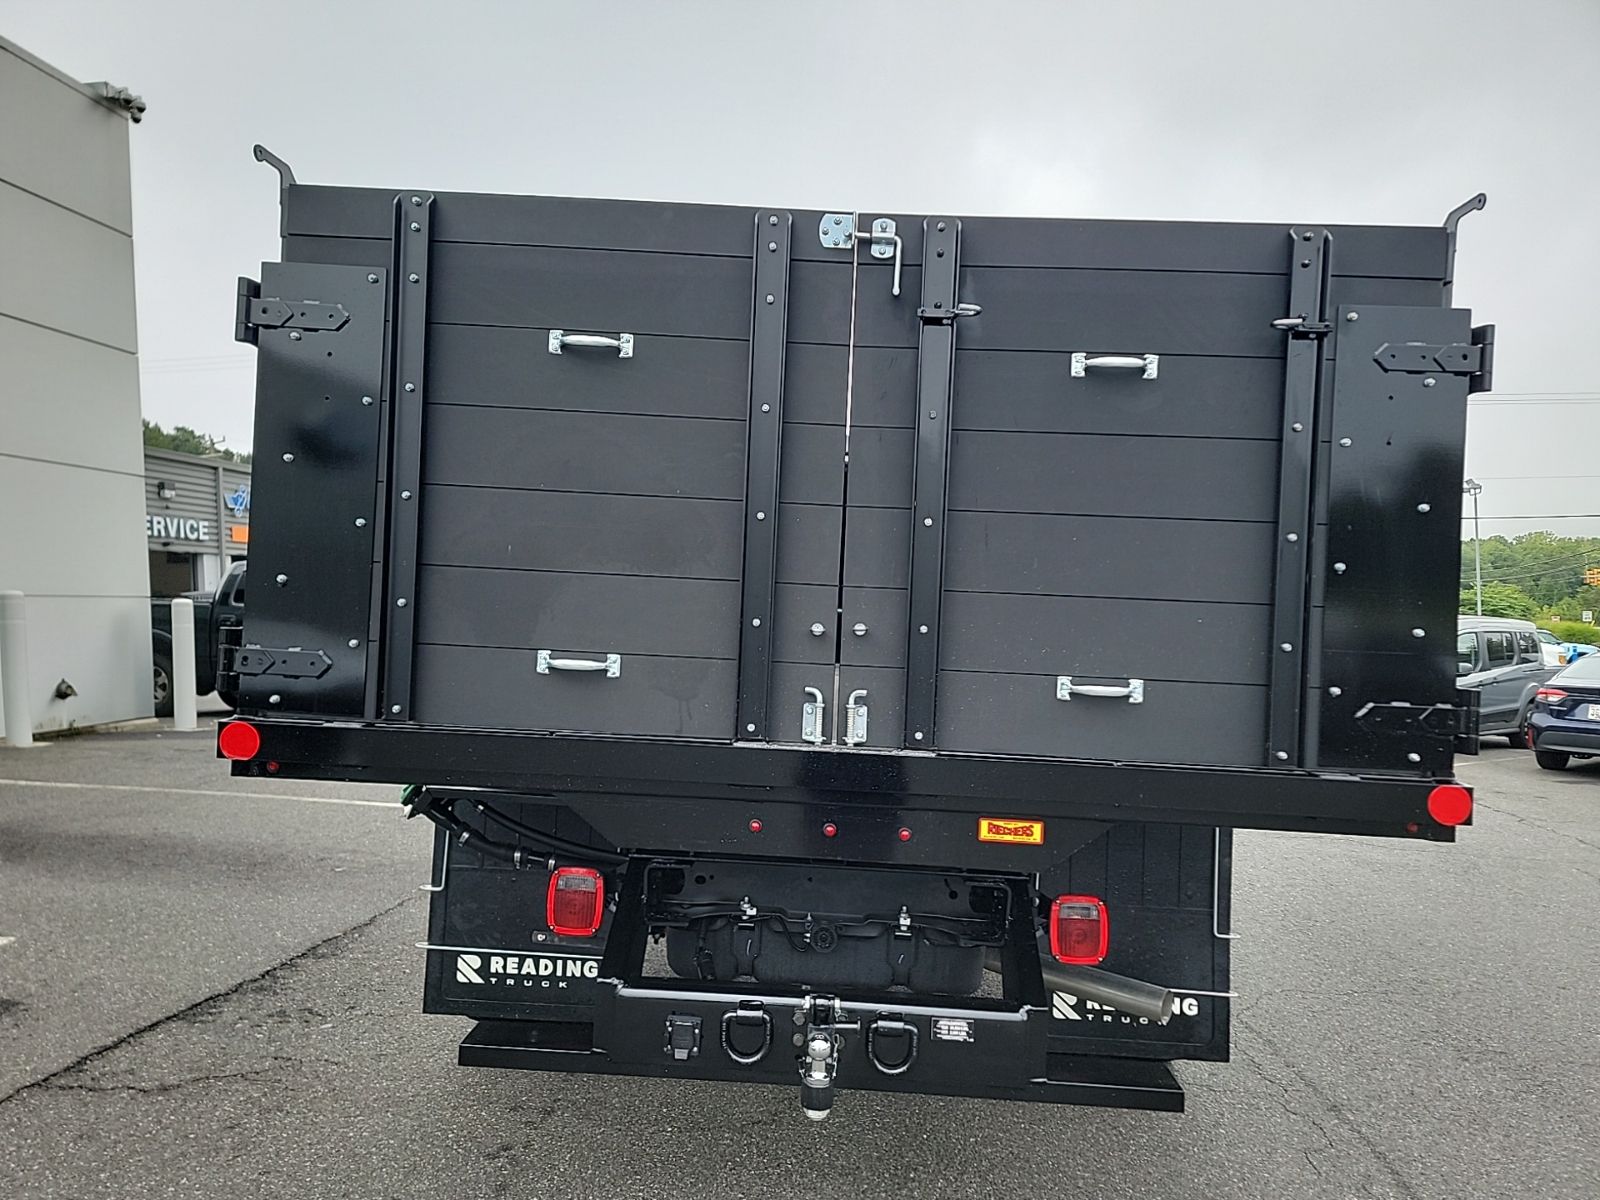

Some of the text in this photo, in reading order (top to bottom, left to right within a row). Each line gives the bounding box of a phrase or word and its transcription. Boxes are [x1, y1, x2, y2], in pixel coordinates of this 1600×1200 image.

[490, 956, 599, 978] READING
[490, 977, 568, 988] TRUCK
[1086, 1014, 1167, 1026] TRUC
